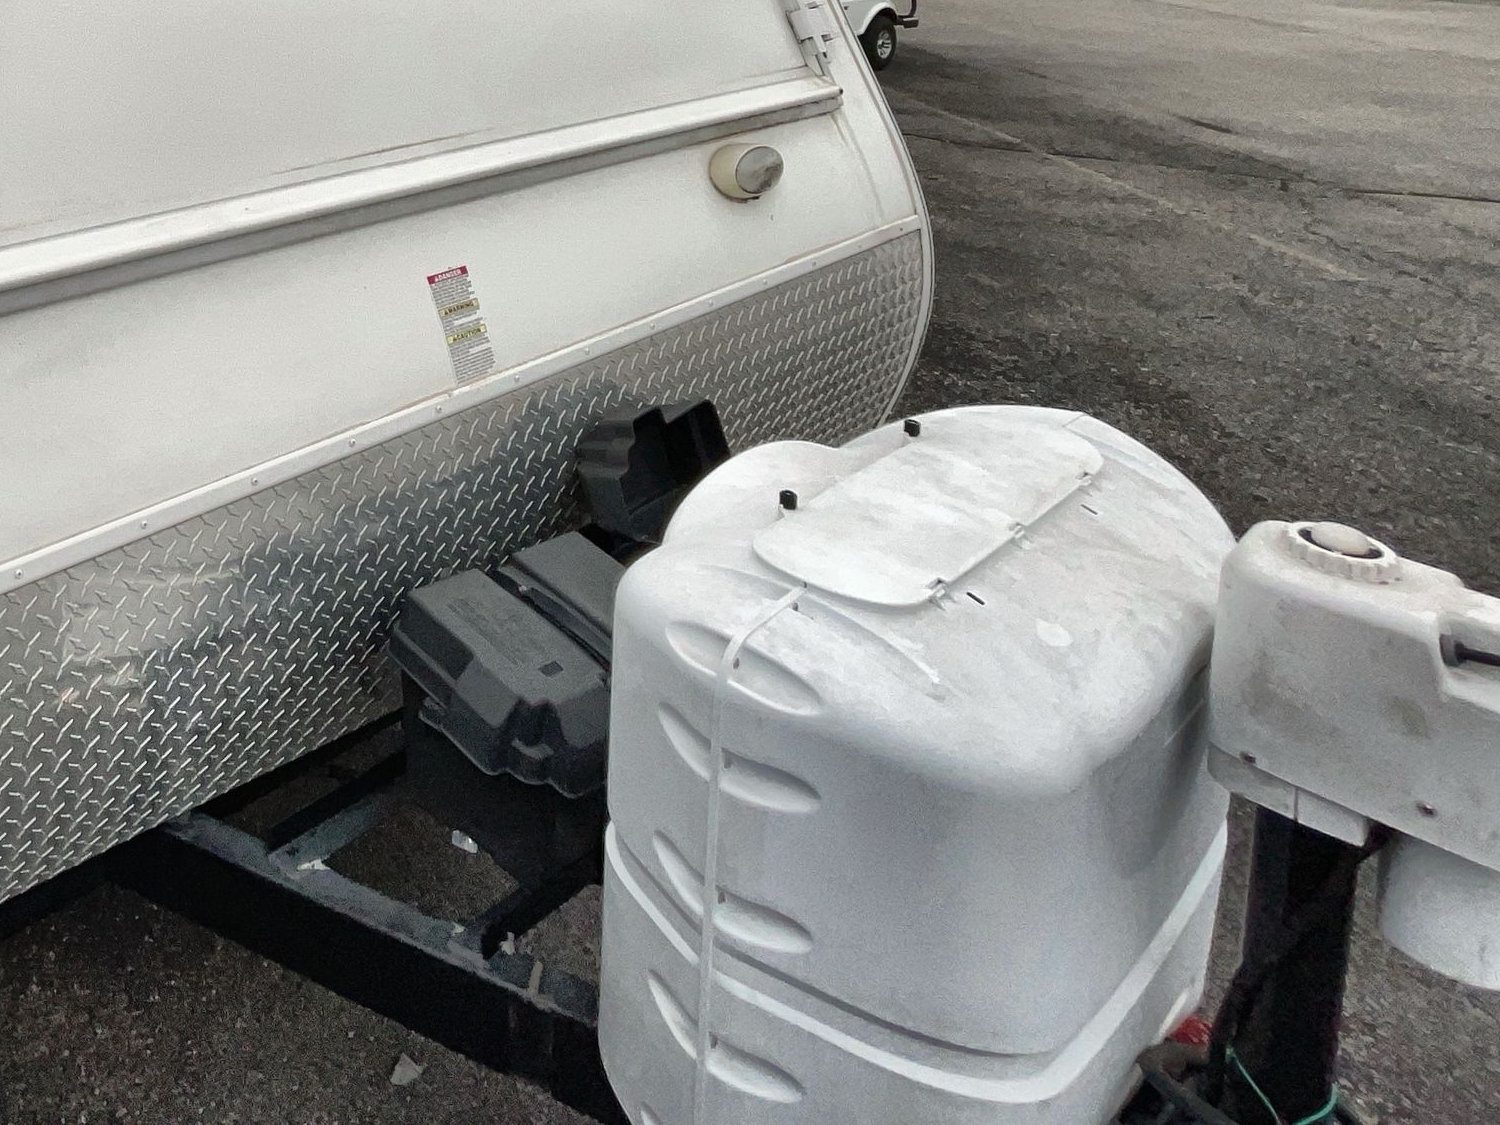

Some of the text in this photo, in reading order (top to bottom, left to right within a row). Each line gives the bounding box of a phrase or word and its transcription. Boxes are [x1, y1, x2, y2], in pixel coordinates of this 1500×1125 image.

[438, 269, 462, 280] DANGER
[448, 300, 474, 313] WARNING
[456, 328, 481, 340] CAUTION
